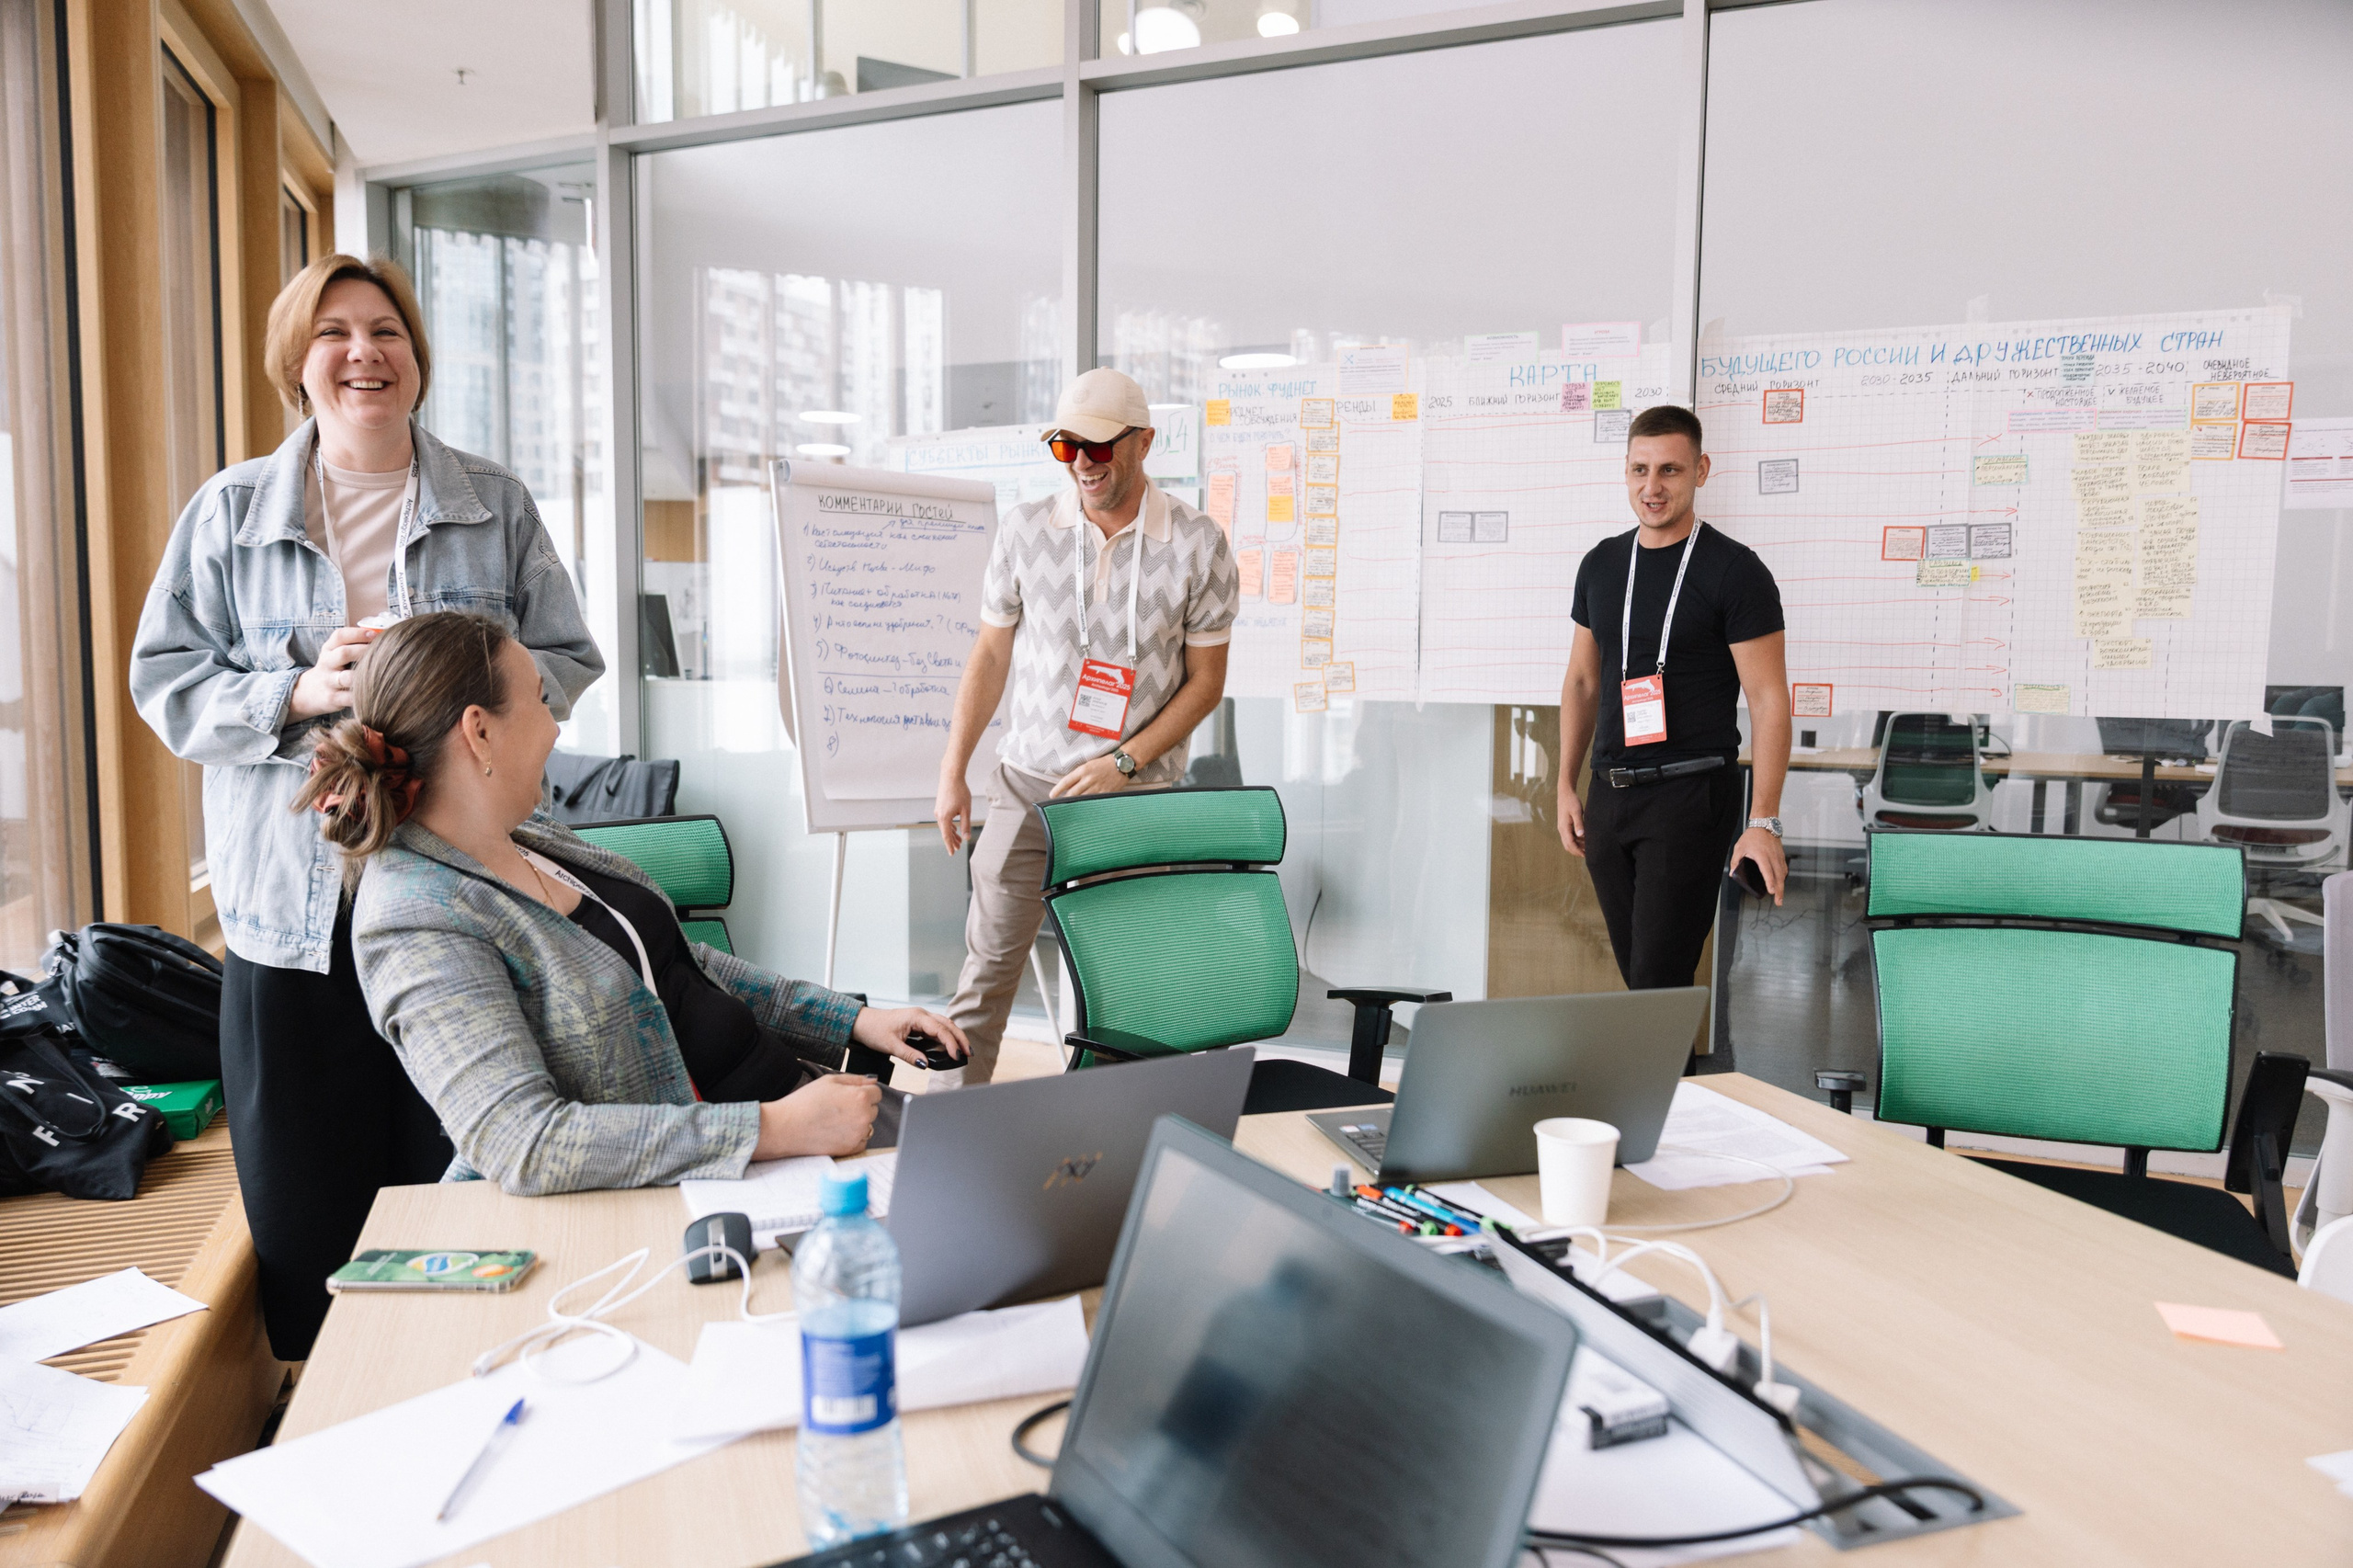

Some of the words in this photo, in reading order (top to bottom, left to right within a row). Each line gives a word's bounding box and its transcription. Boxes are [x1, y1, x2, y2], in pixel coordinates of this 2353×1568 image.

[1700, 349, 1823, 382] БУДУЩЕГО
[1834, 345, 1920, 369] РОССИИ
[1930, 342, 1948, 364] И
[1952, 333, 2143, 367] ДРУЖЕСТВЕННЫХ
[2160, 330, 2224, 353] СТРАН
[2203, 358, 2250, 370] ОЧЕВИДНОЕ
[1509, 364, 1598, 387] КАРТА
[1951, 369, 2001, 383] ДАЛЬНИЙ
[2009, 368, 2059, 380] ГОРИЗОНТ
[2211, 369, 2270, 381] НЕВЕРОЯТНОЕ
[1218, 382, 1261, 398] РЫНОК
[1267, 380, 1317, 398] ФУДНЕТ
[1714, 381, 1759, 396] СРЕДНИЙ
[1769, 379, 1821, 390] ГОРИЗОНТ
[2119, 386, 2160, 395] ЖЕЛАЕМОЕ
[1428, 396, 1453, 409] 2025
[1469, 393, 1509, 406] БЛИЖНИЙ
[1634, 387, 1663, 398] 2030
[1229, 406, 1265, 417] РЕДМЕТ
[1336, 401, 1376, 415] РЕНДЫ
[1244, 414, 1298, 426] ОБСУЖДЕНИЯ
[817, 494, 904, 517] КОММЕНТАРИИ
[826, 731, 839, 758] 8)
